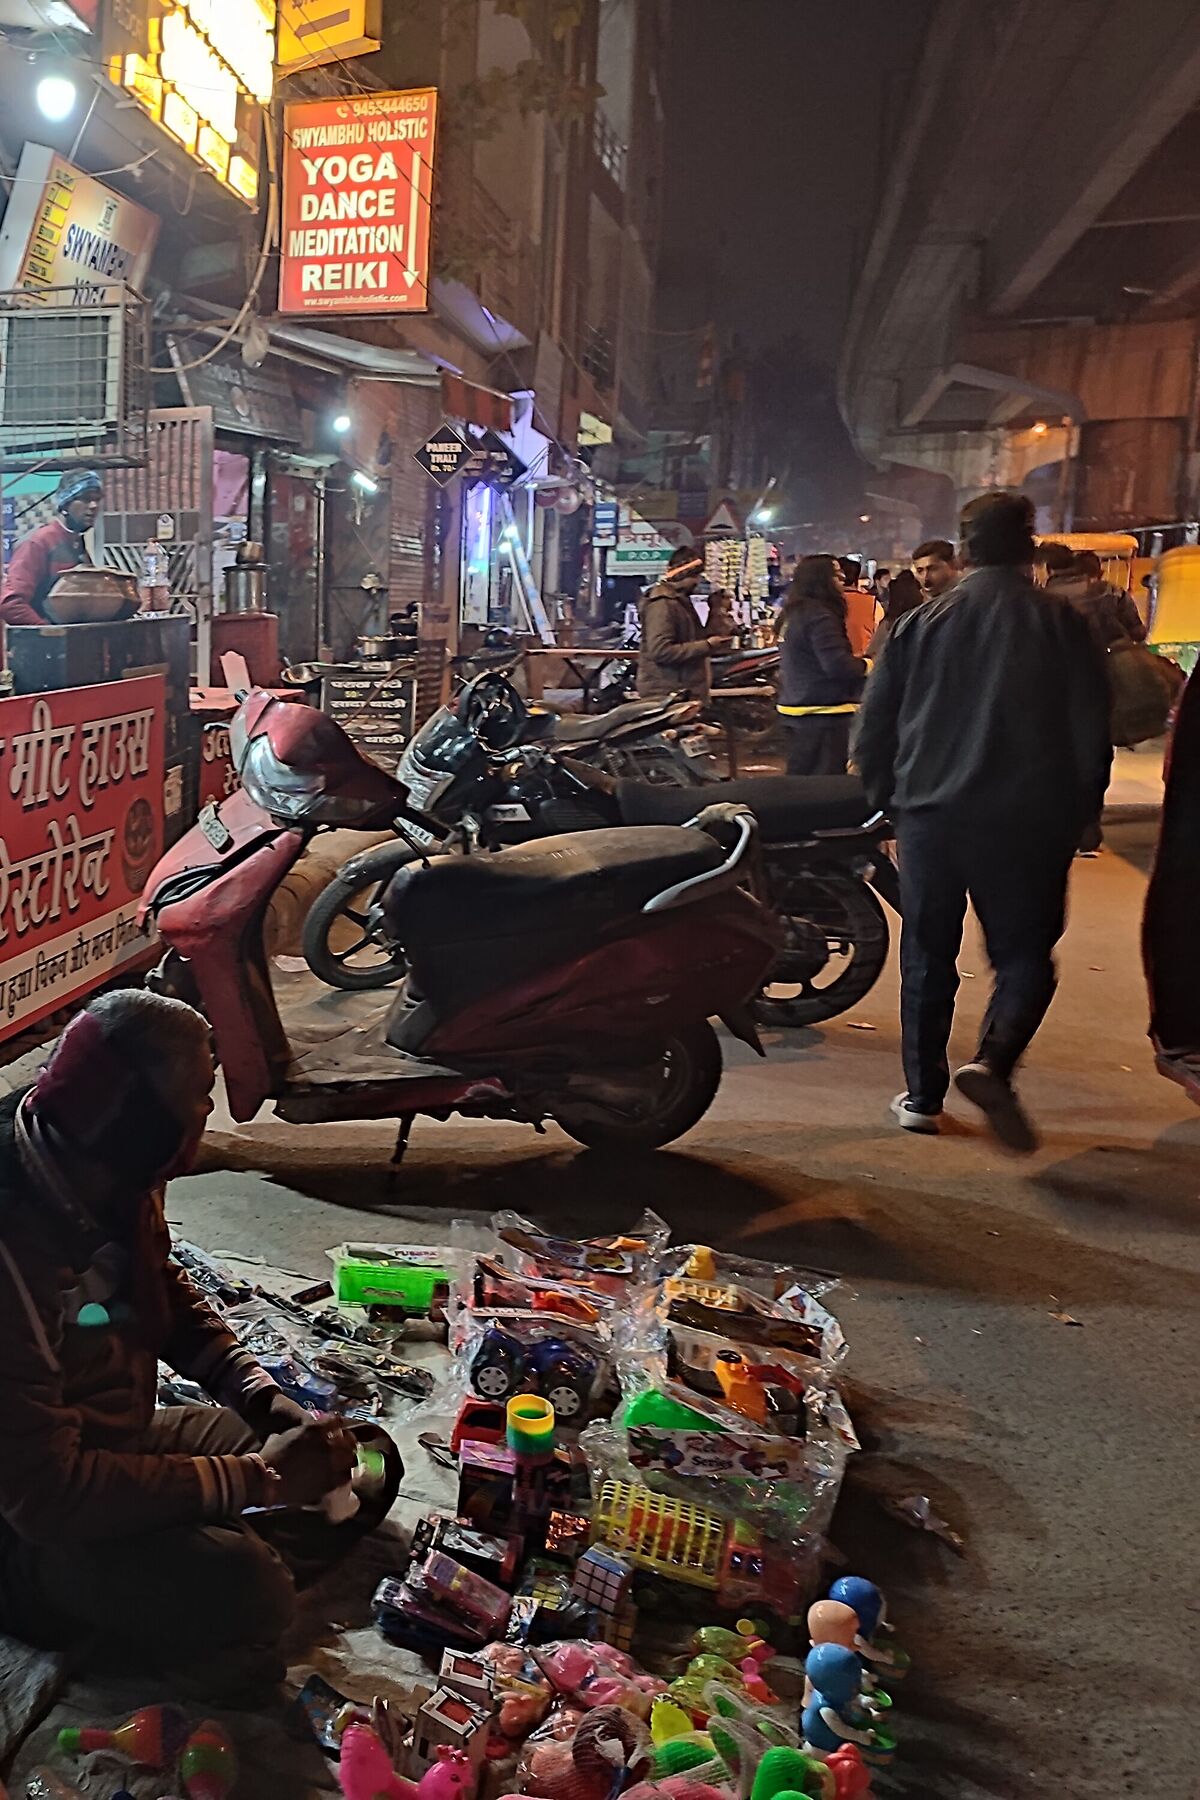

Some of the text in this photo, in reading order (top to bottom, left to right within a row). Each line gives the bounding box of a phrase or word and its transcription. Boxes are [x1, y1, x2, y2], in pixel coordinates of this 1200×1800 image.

[291, 117, 428, 149] SWYAMBHU HOLISTIC
[301, 152, 398, 185] YOGA
[300, 189, 396, 221] DANCE
[289, 225, 404, 257] MEDITATION
[301, 261, 388, 292] REIKI
[425, 442, 462, 453] PANEER
[430, 453, 457, 463] THALI
[8, 700, 77, 808] मीट
[79, 708, 155, 807] हाउस
[7, 967, 34, 1018] हुआ
[35, 950, 69, 992] चिकन
[70, 931, 91, 974] और
[691, 1454, 734, 1471] Series
